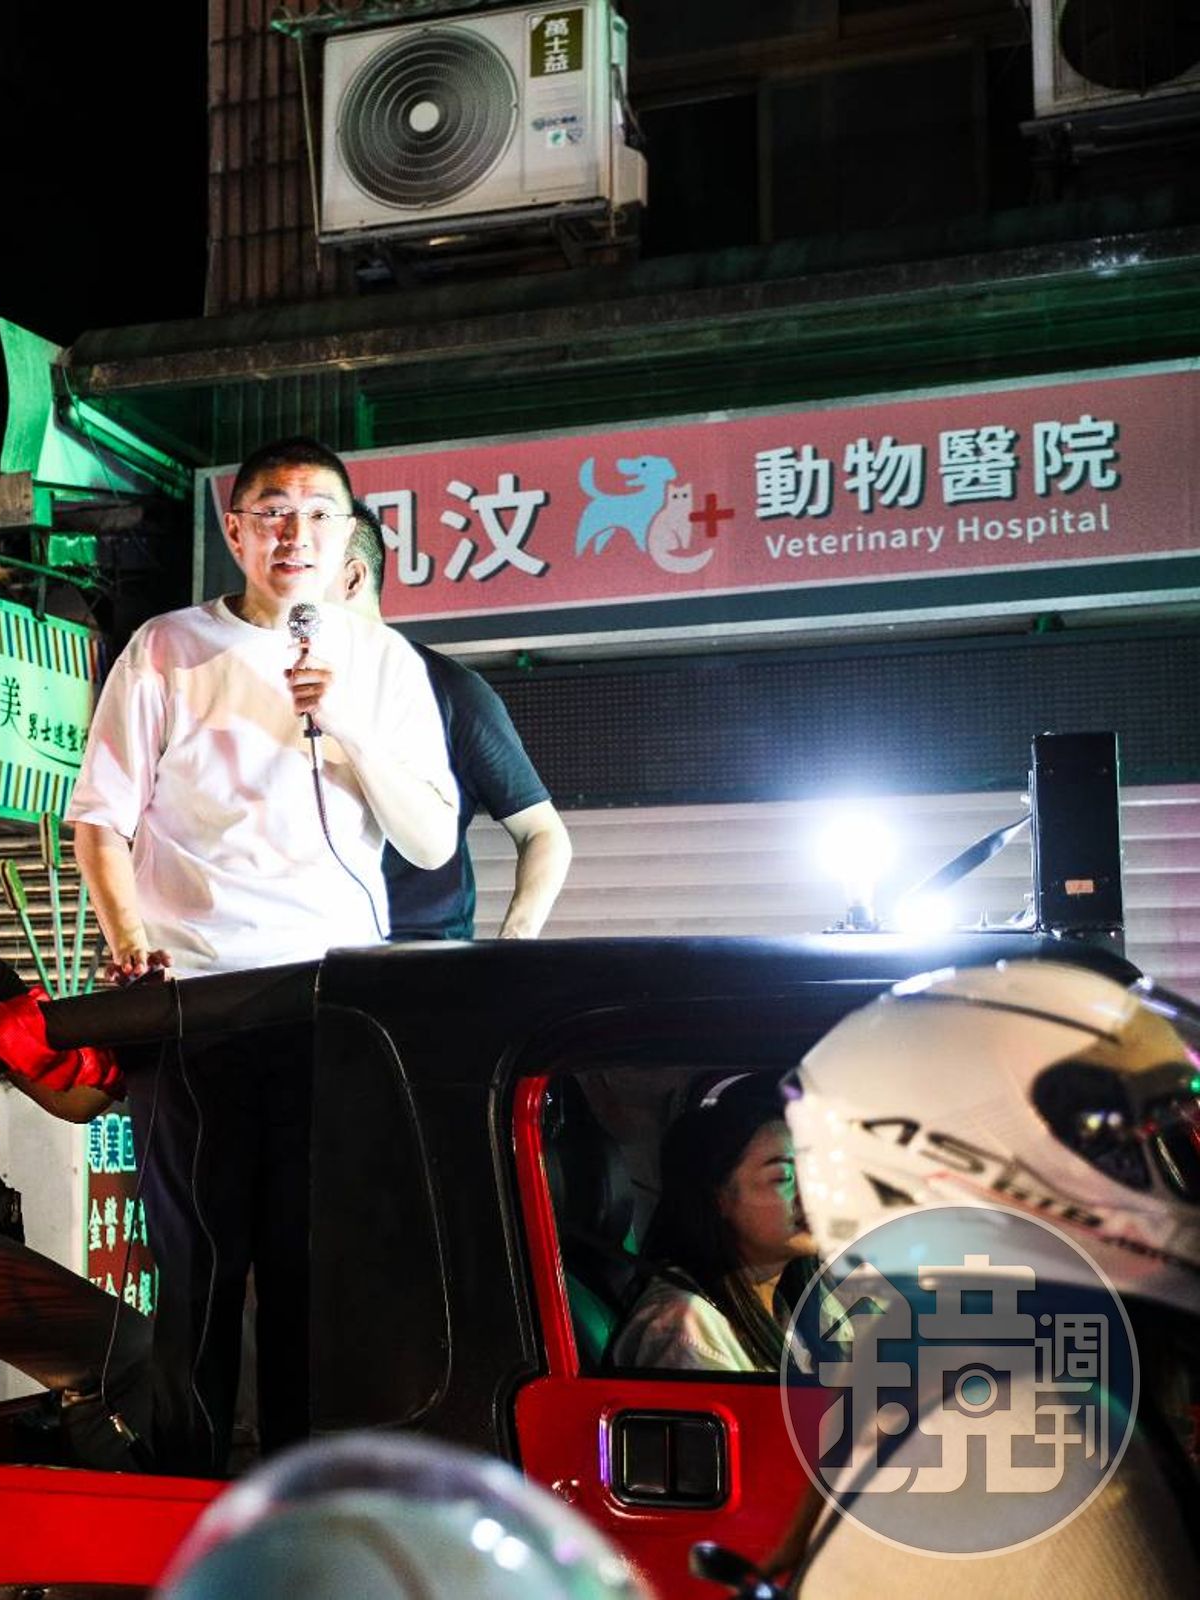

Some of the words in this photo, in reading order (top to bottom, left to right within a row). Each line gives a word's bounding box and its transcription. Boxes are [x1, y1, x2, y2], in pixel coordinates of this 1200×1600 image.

[755, 413, 1121, 519] 動物醫院
[765, 524, 944, 560] Veterinary
[957, 503, 1111, 544] Hospital
